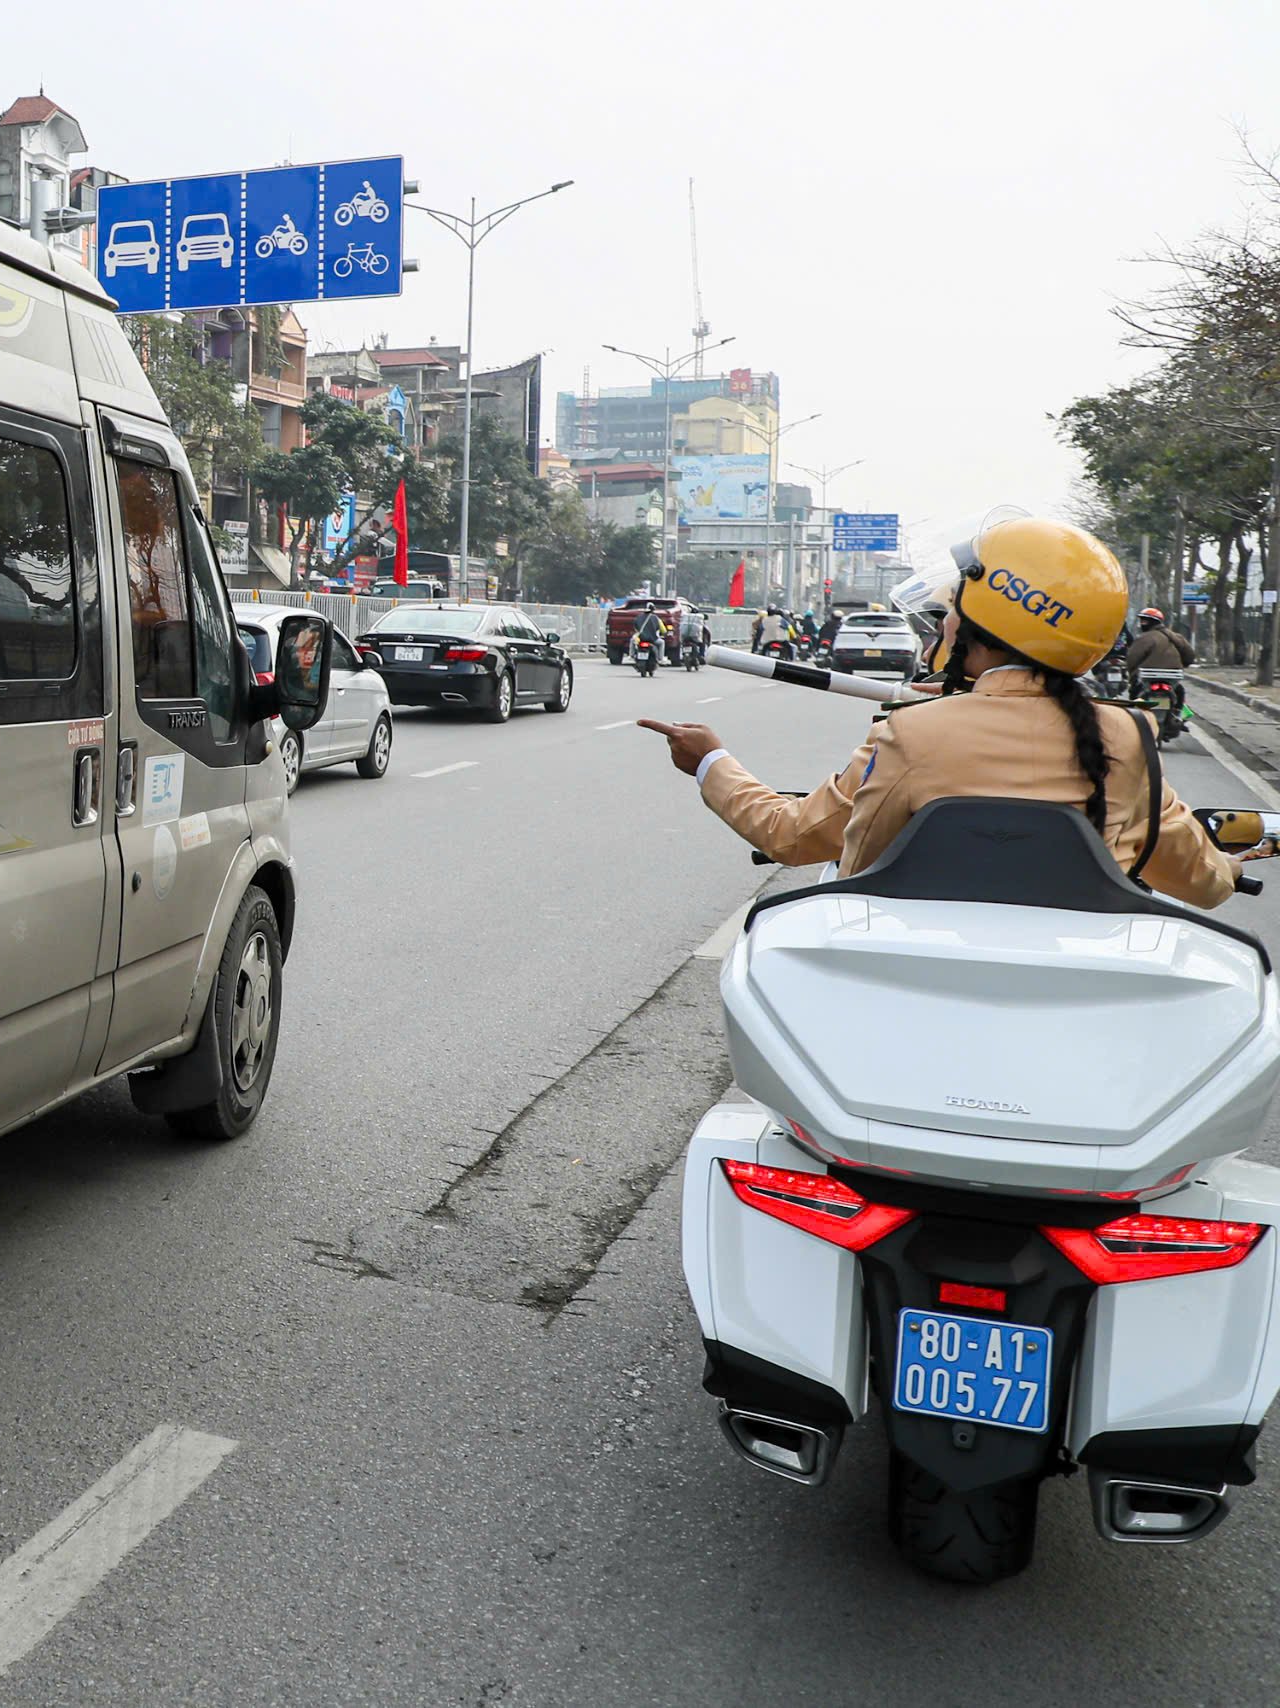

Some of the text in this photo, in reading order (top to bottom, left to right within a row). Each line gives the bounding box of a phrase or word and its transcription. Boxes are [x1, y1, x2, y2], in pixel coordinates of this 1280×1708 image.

[988, 568, 1073, 627] CSGT
[168, 711, 207, 728] TRANSIT
[945, 1095, 1031, 1115] HONDA
[919, 1317, 1025, 1374] 80-A1
[905, 1363, 1039, 1424] 005.77
